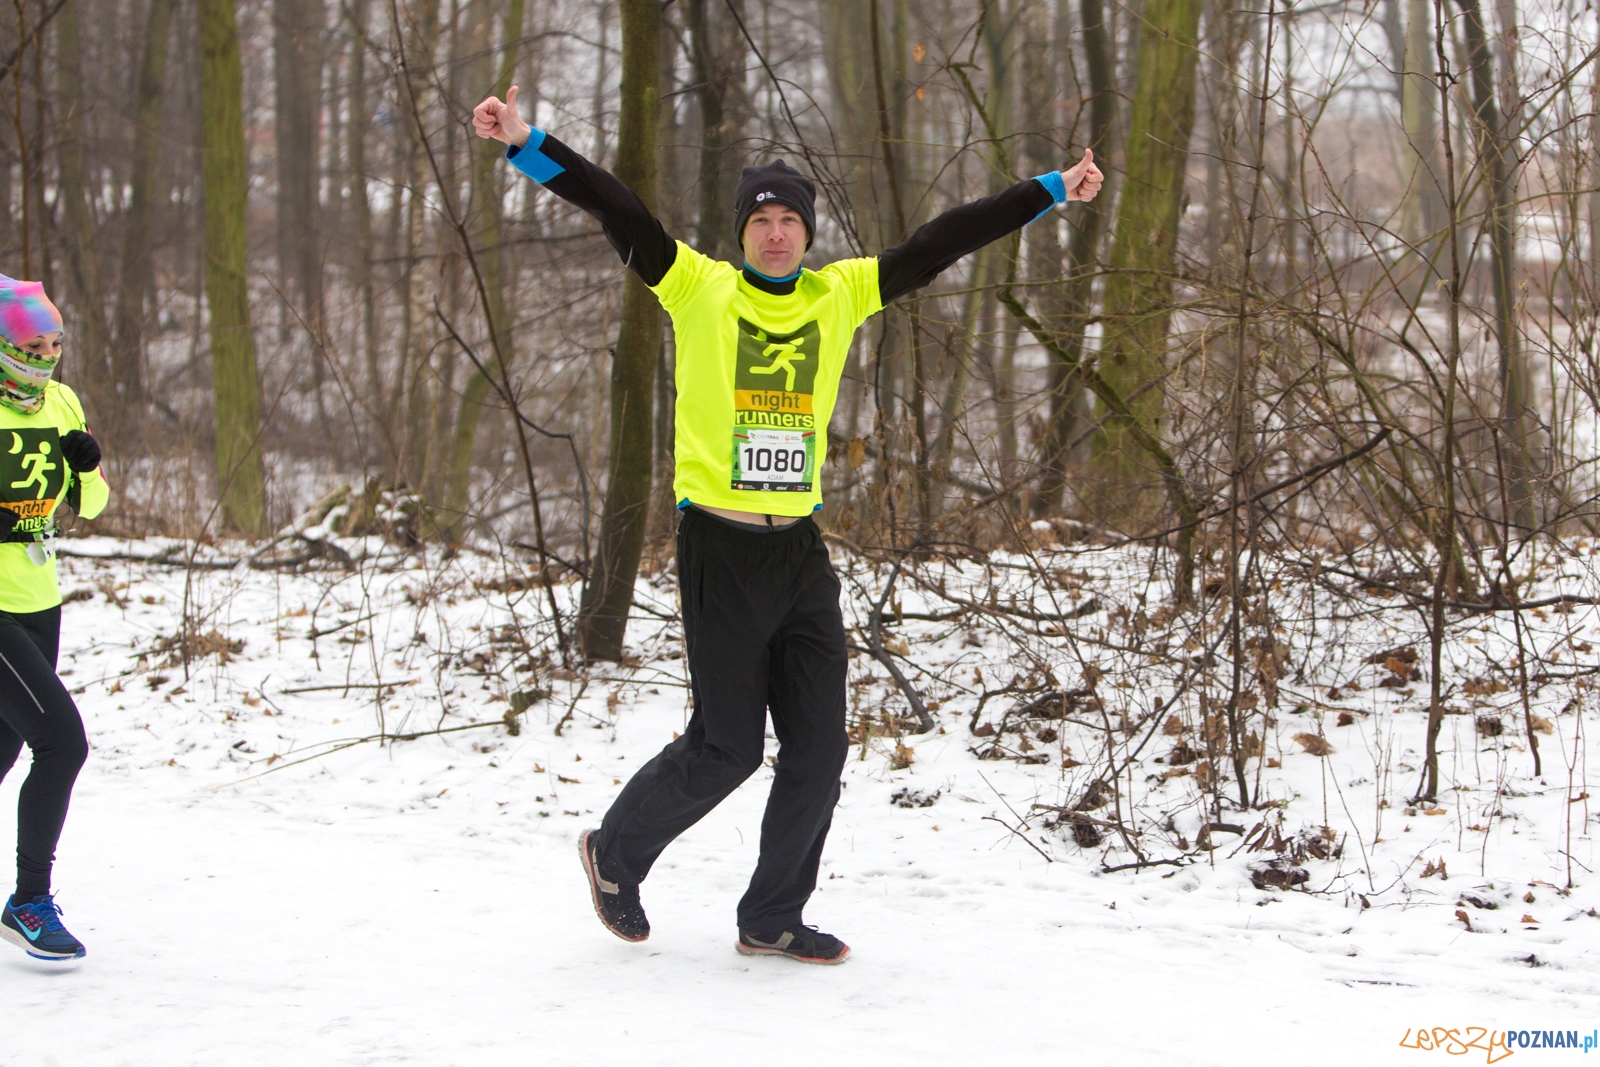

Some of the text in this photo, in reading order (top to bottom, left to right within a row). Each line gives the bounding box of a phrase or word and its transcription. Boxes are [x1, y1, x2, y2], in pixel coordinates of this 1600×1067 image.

[751, 391, 800, 411] night
[735, 411, 814, 428] runners
[744, 447, 806, 473] 1080
[13, 500, 46, 517] night
